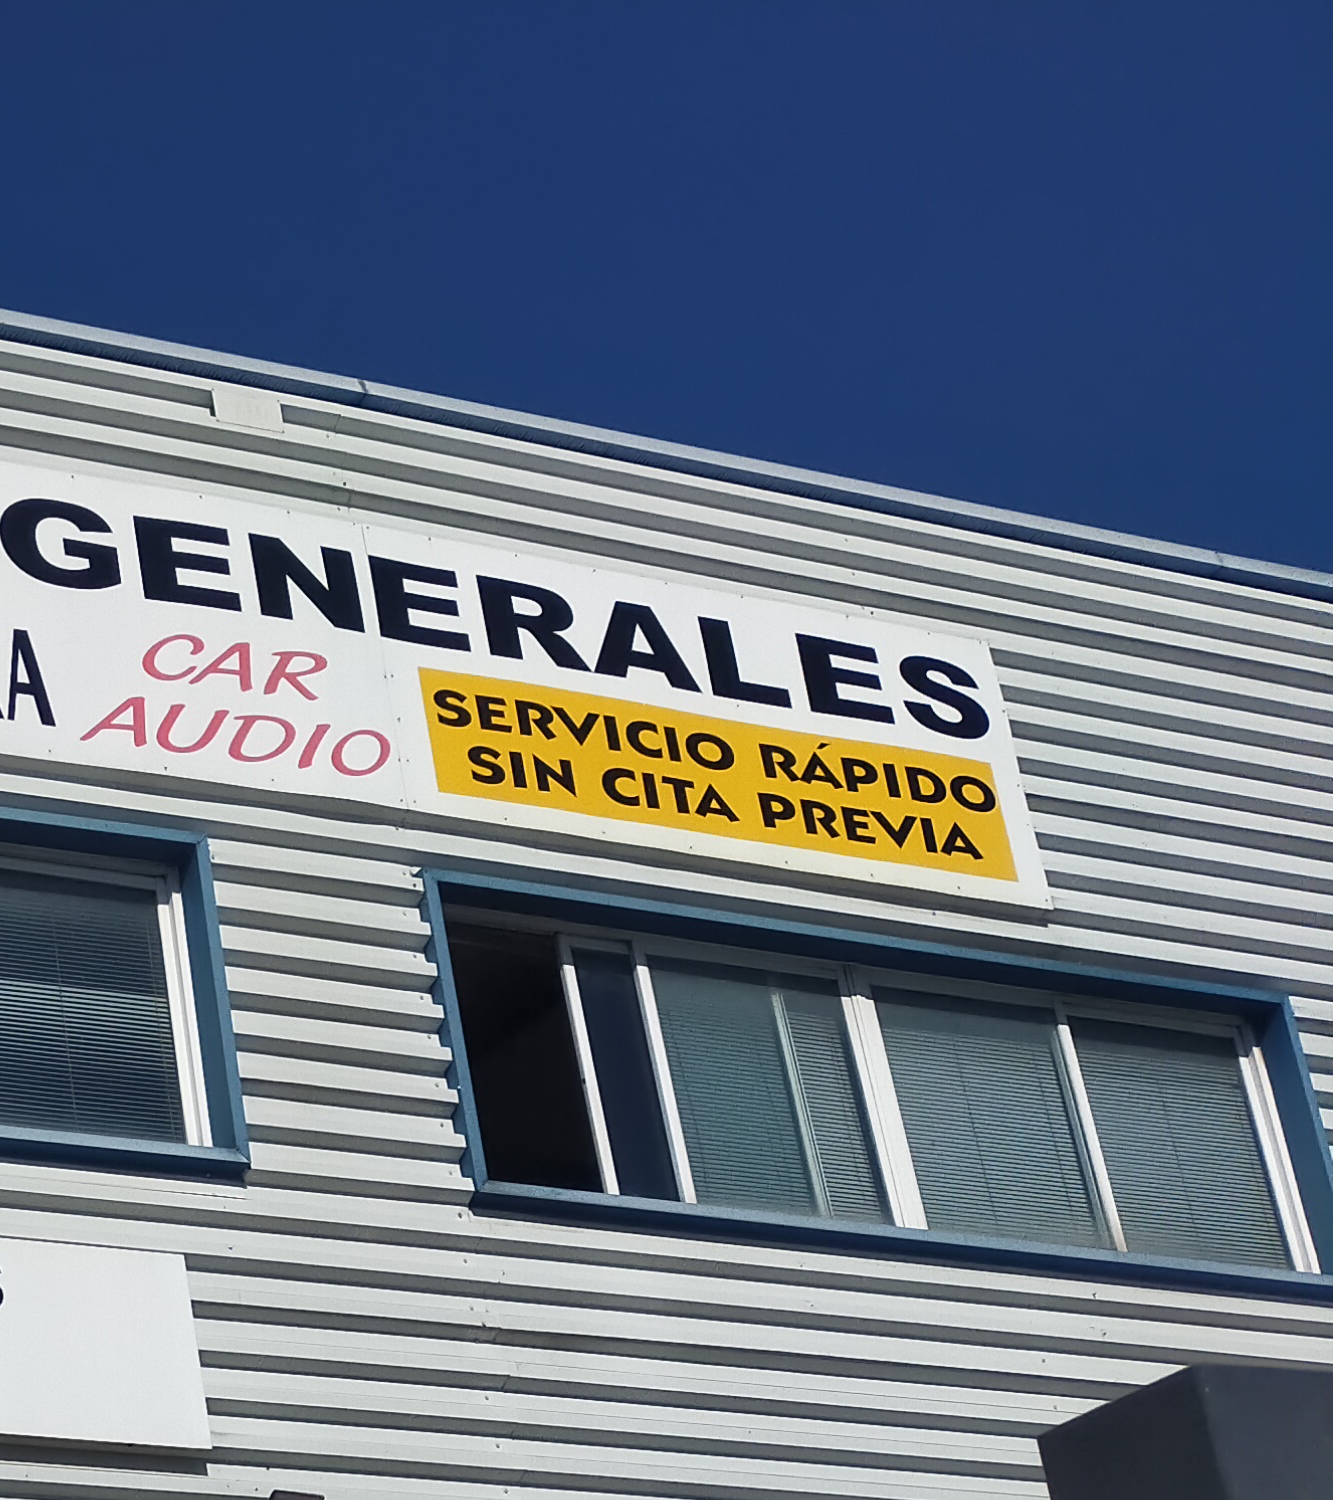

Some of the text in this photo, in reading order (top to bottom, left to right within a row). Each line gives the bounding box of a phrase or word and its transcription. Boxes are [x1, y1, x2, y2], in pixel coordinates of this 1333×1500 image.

[0, 497, 990, 739] GENERALES
[141, 632, 328, 702] CAR
[80, 696, 391, 778] AUDIO
[434, 688, 998, 814] SERVICIO RÁPIDO
[467, 745, 984, 860] SIN CITA PREVIA
